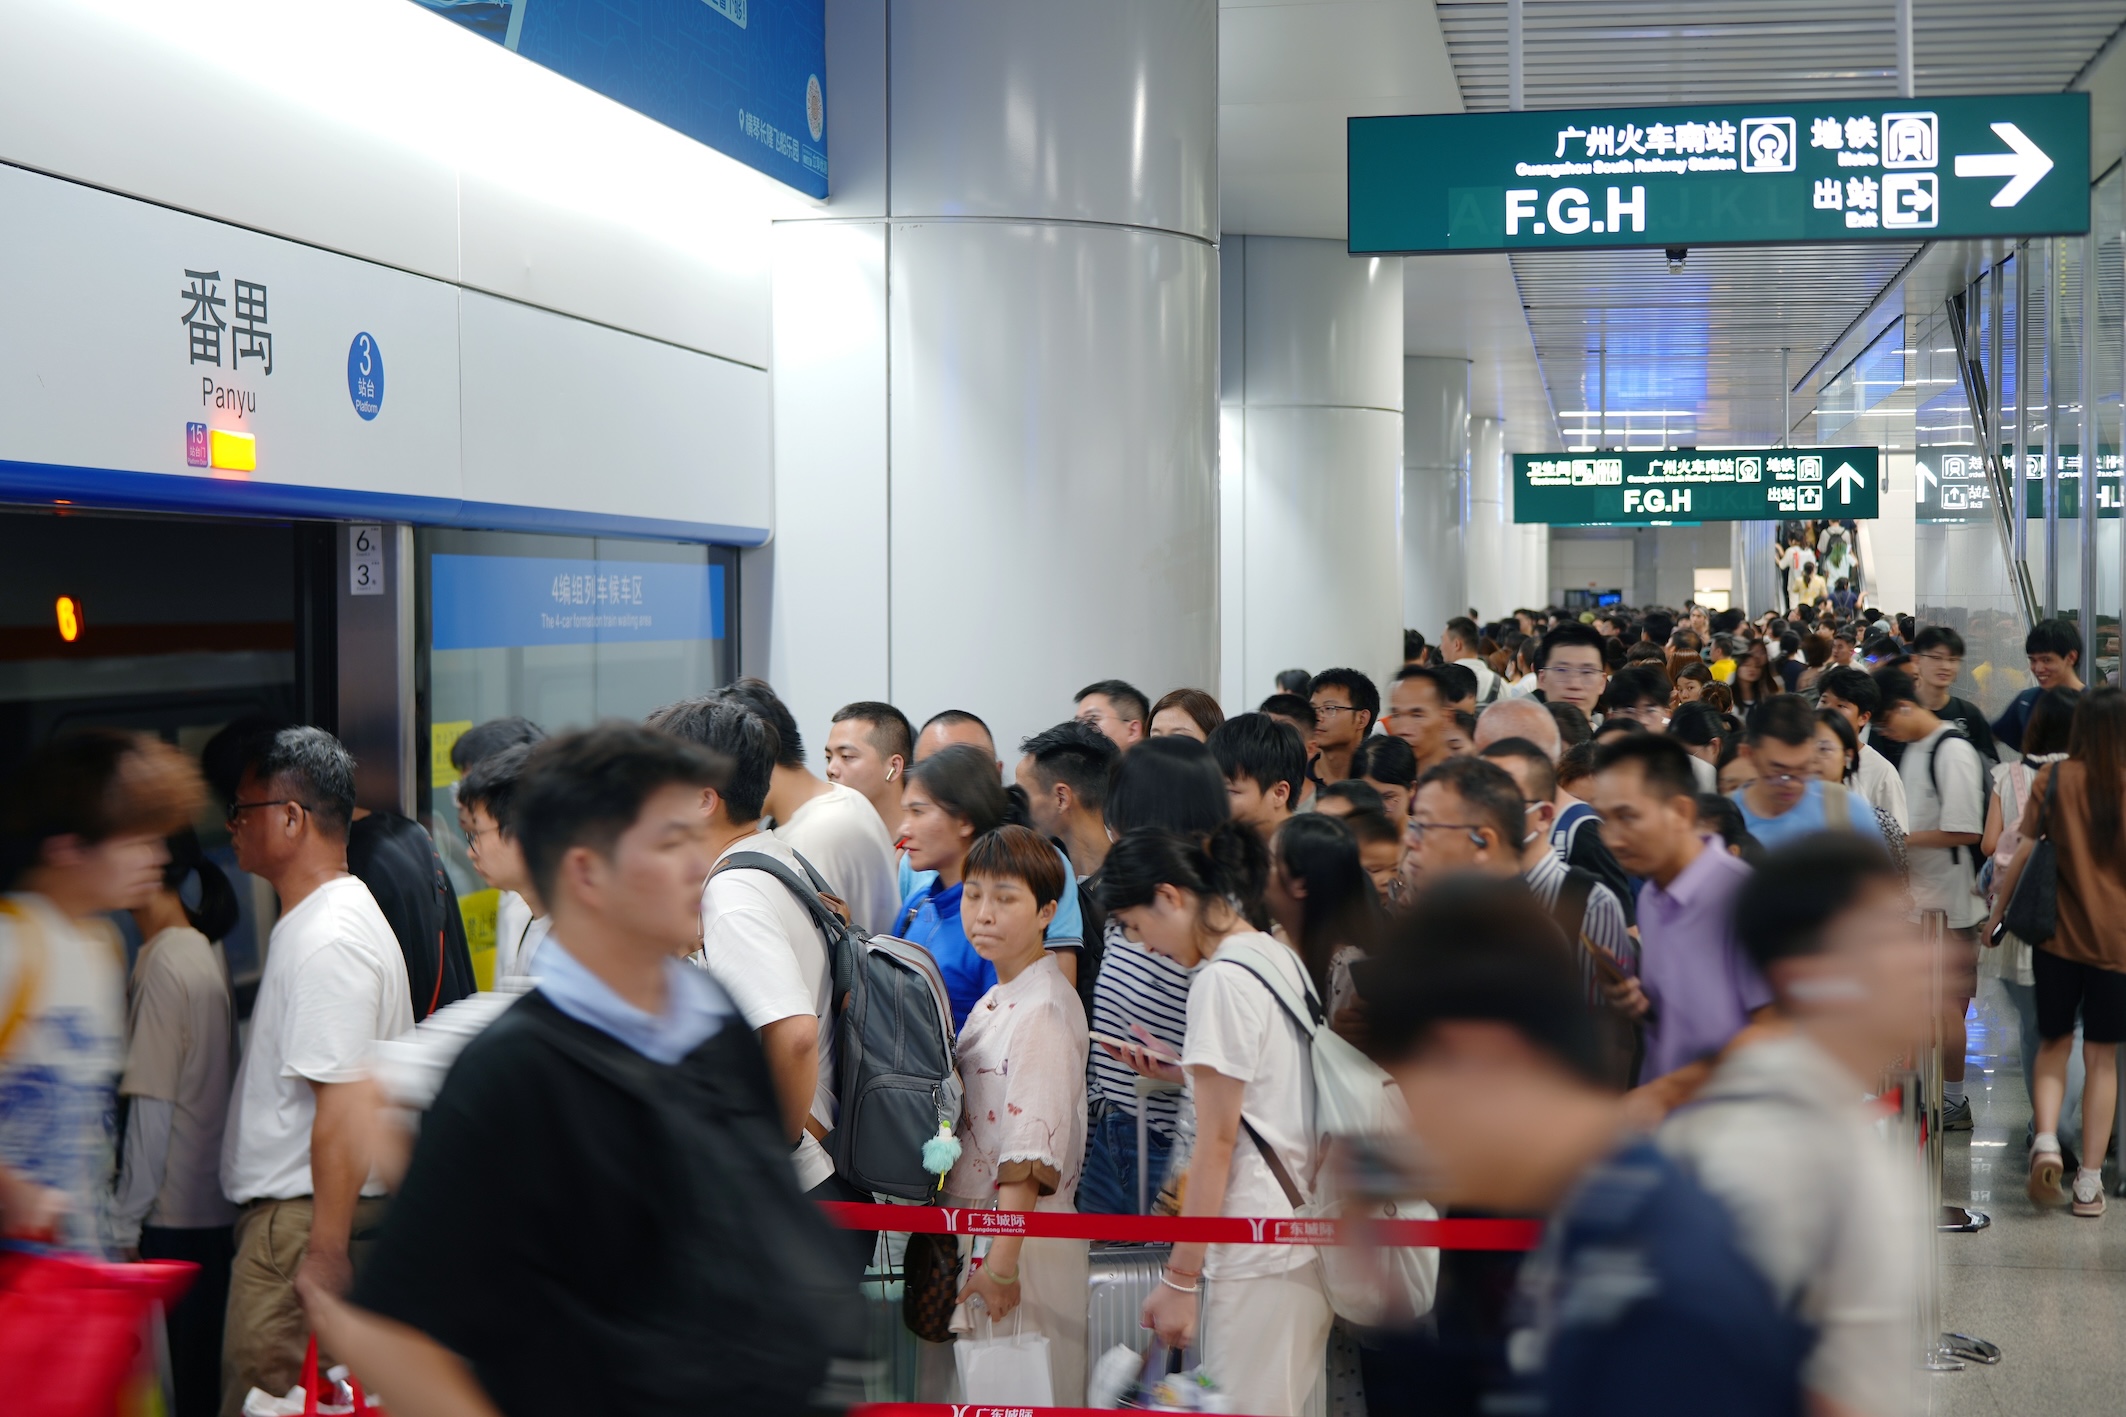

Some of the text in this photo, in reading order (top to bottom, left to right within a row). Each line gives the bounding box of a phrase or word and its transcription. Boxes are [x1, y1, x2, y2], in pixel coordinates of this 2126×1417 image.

[1555, 120, 1737, 158] 广州火车南站
[1810, 116, 1879, 150] 地铁
[1516, 161, 1592, 178] Guangzhou
[1593, 159, 1633, 174] South
[1813, 176, 1879, 210] 出站
[1505, 186, 1646, 235] F.G.H
[1845, 211, 1879, 229] Exit
[181, 268, 273, 377] 番禺
[359, 334, 372, 376] 3
[202, 376, 256, 419] Panyu
[358, 377, 375, 399] 站台
[355, 399, 379, 414] Platform
[190, 424, 204, 444] 15
[189, 446, 207, 459] 站台门
[1648, 458, 1735, 475] 广州火车南站
[1766, 457, 1796, 472] 地铁
[1623, 488, 1692, 513] F.G.H
[1767, 486, 1796, 501] 出站
[356, 530, 370, 552] 6
[357, 564, 370, 586] 3
[551, 574, 643, 605] 4编组列车候车区
[541, 613, 554, 629] The
[555, 613, 572, 629] 4-car
[639, 615, 653, 628] area
[967, 1213, 1026, 1227] 广东城际
